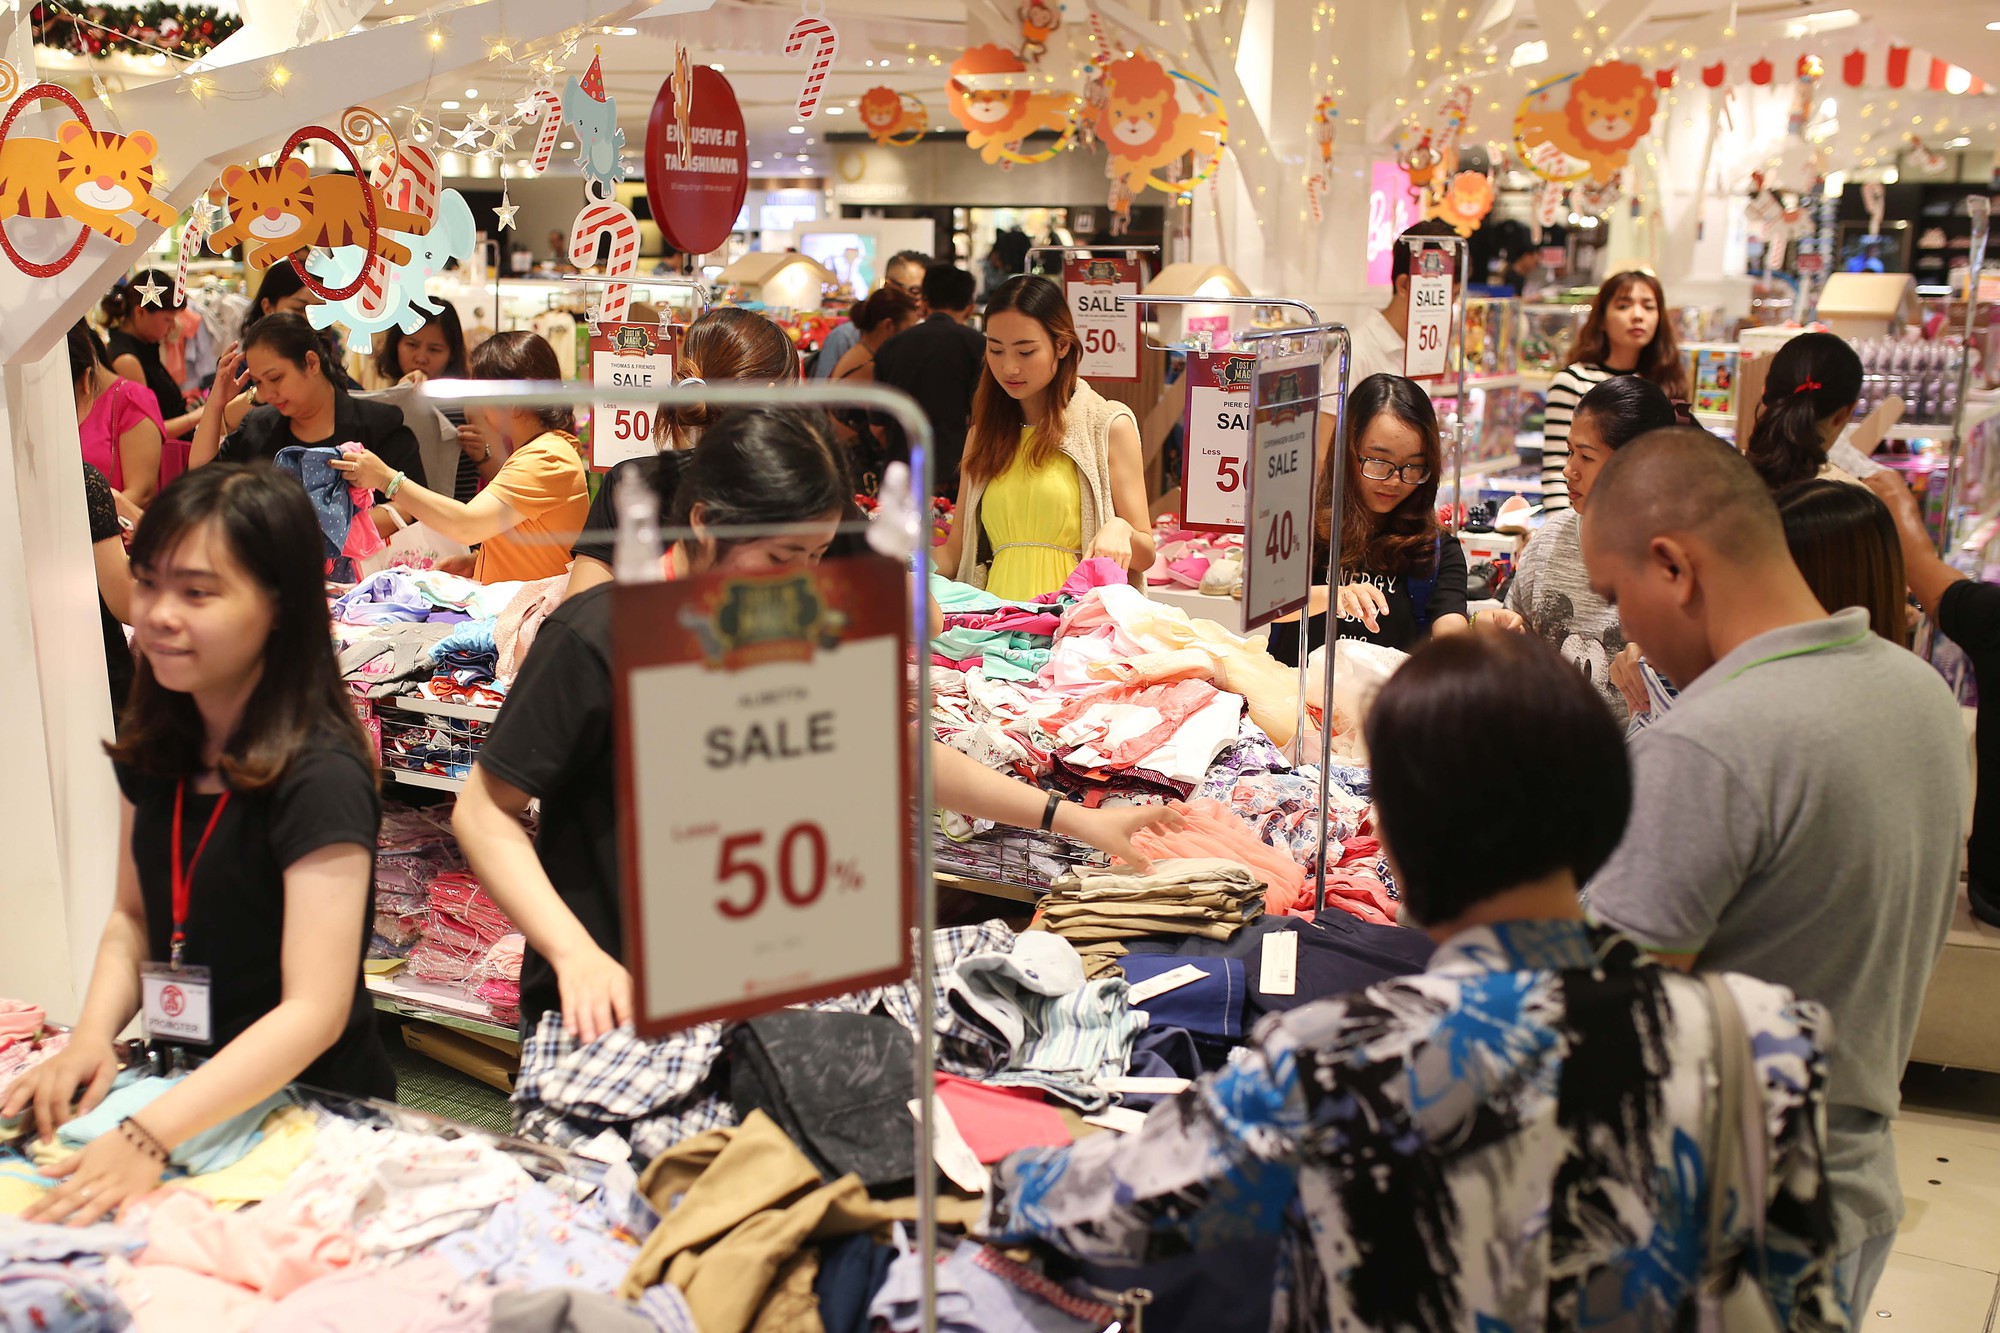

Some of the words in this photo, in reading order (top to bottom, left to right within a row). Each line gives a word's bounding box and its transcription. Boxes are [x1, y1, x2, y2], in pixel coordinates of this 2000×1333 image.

[666, 124, 723, 146] EXUSIVE
[724, 130, 738, 147] AT
[664, 154, 739, 174] TAASHIMAYA
[1078, 296, 1125, 312] SALE
[1416, 290, 1445, 306] SALE
[1236, 361, 1250, 370] LOST
[613, 373, 652, 388] SALE
[1234, 370, 1252, 379] MAG
[1217, 413, 1250, 430] SA
[1202, 447, 1221, 455] Less
[1268, 450, 1298, 479] SALE
[1216, 456, 1248, 493] 5
[705, 711, 836, 770] SALE
